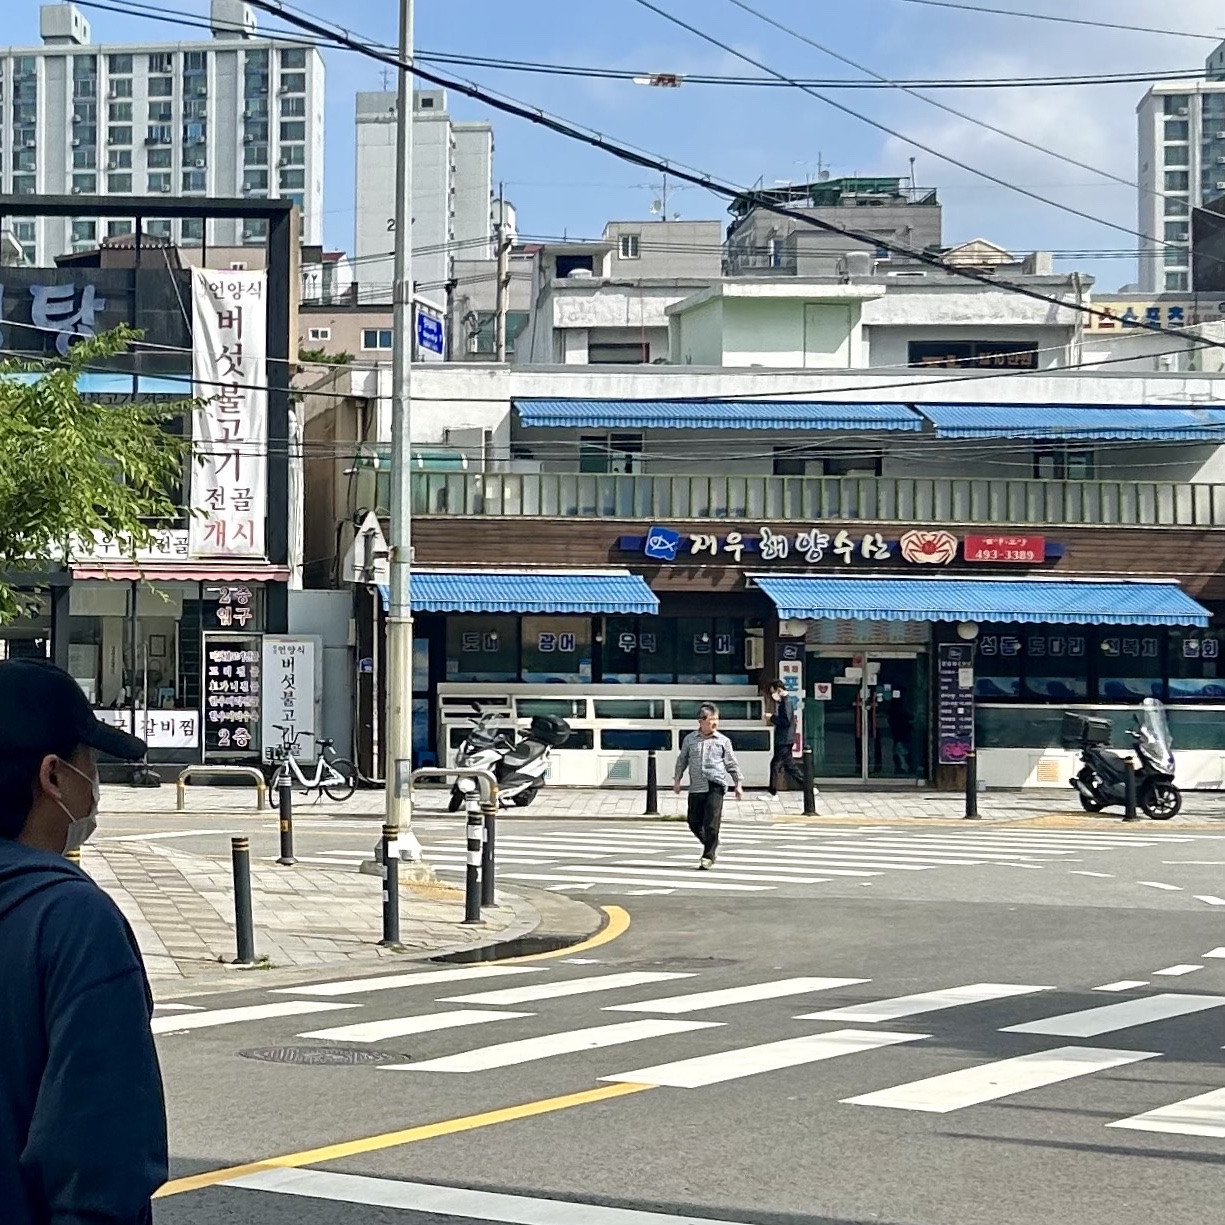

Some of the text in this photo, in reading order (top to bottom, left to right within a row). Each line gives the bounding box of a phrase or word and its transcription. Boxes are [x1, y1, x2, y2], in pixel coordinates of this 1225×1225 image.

[209, 280, 262, 301] 언양식
[215, 305, 246, 483] 버섯불고기
[204, 485, 254, 512] 전골
[203, 519, 254, 548] 개시
[975, 549, 1035, 560] 493-3389
[218, 585, 253, 605] 2층
[216, 606, 253, 627] 입구
[537, 632, 576, 652] 광어
[618, 632, 657, 652] 우럭
[1026, 636, 1085, 657] 도다리
[217, 727, 252, 747] 2층
